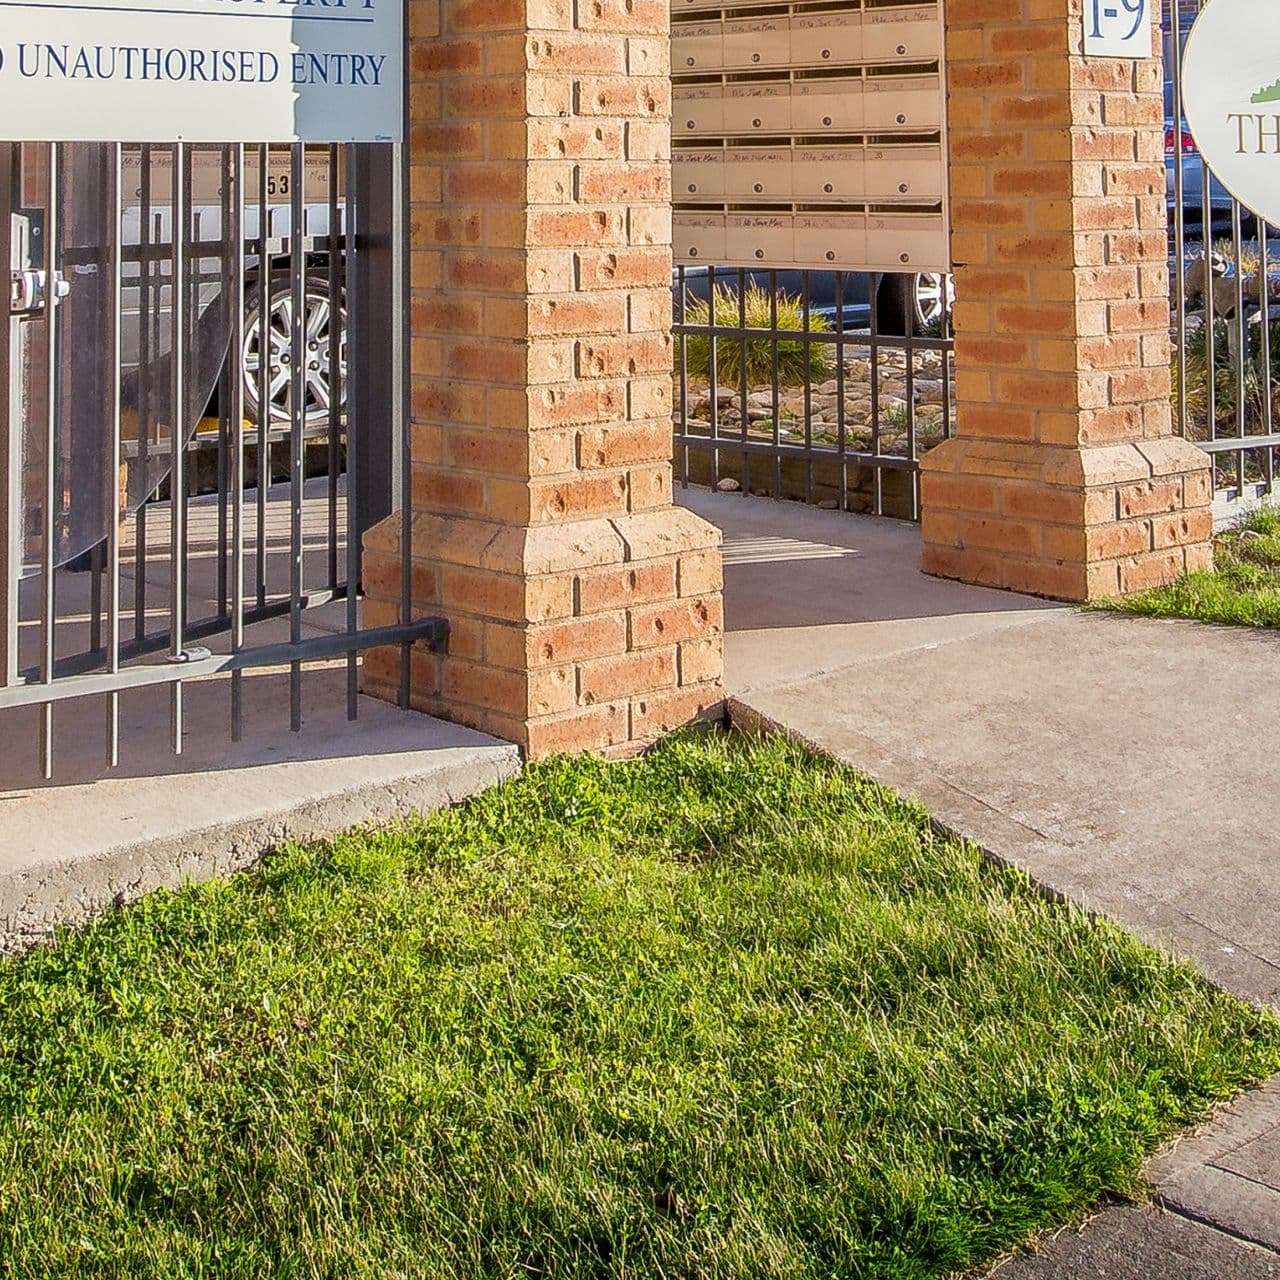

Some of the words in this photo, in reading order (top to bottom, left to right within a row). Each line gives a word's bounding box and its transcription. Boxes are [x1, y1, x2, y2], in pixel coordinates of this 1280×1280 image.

[17, 43, 279, 82] UNAUTHORISED
[290, 52, 386, 85] ENTRY
[267, 176, 289, 195] 53
